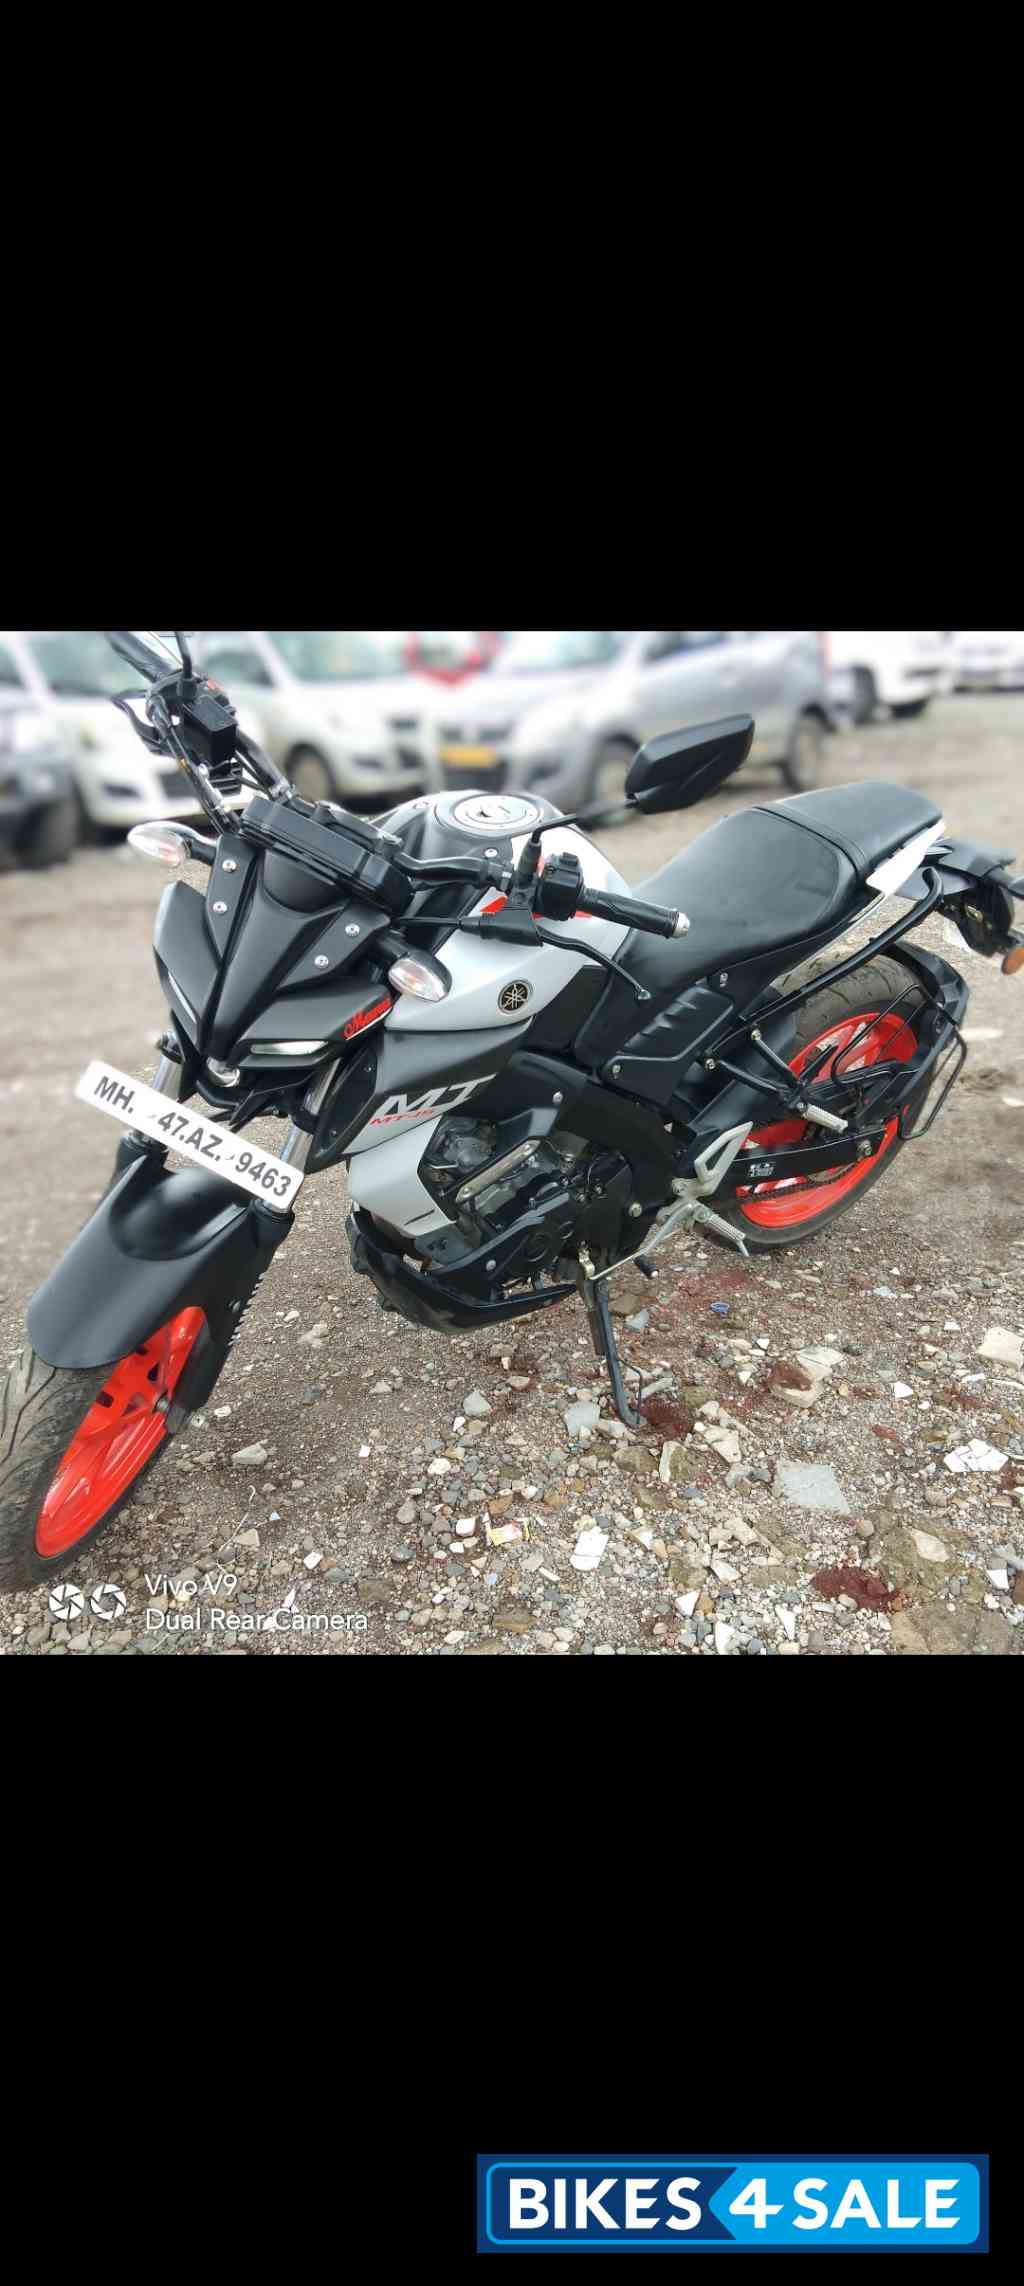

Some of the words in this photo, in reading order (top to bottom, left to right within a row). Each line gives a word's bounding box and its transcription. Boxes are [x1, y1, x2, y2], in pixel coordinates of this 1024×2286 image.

[93, 1075, 135, 1114] MH.
[235, 1152, 292, 1197] 9463
[368, 1073, 497, 1120] MT
